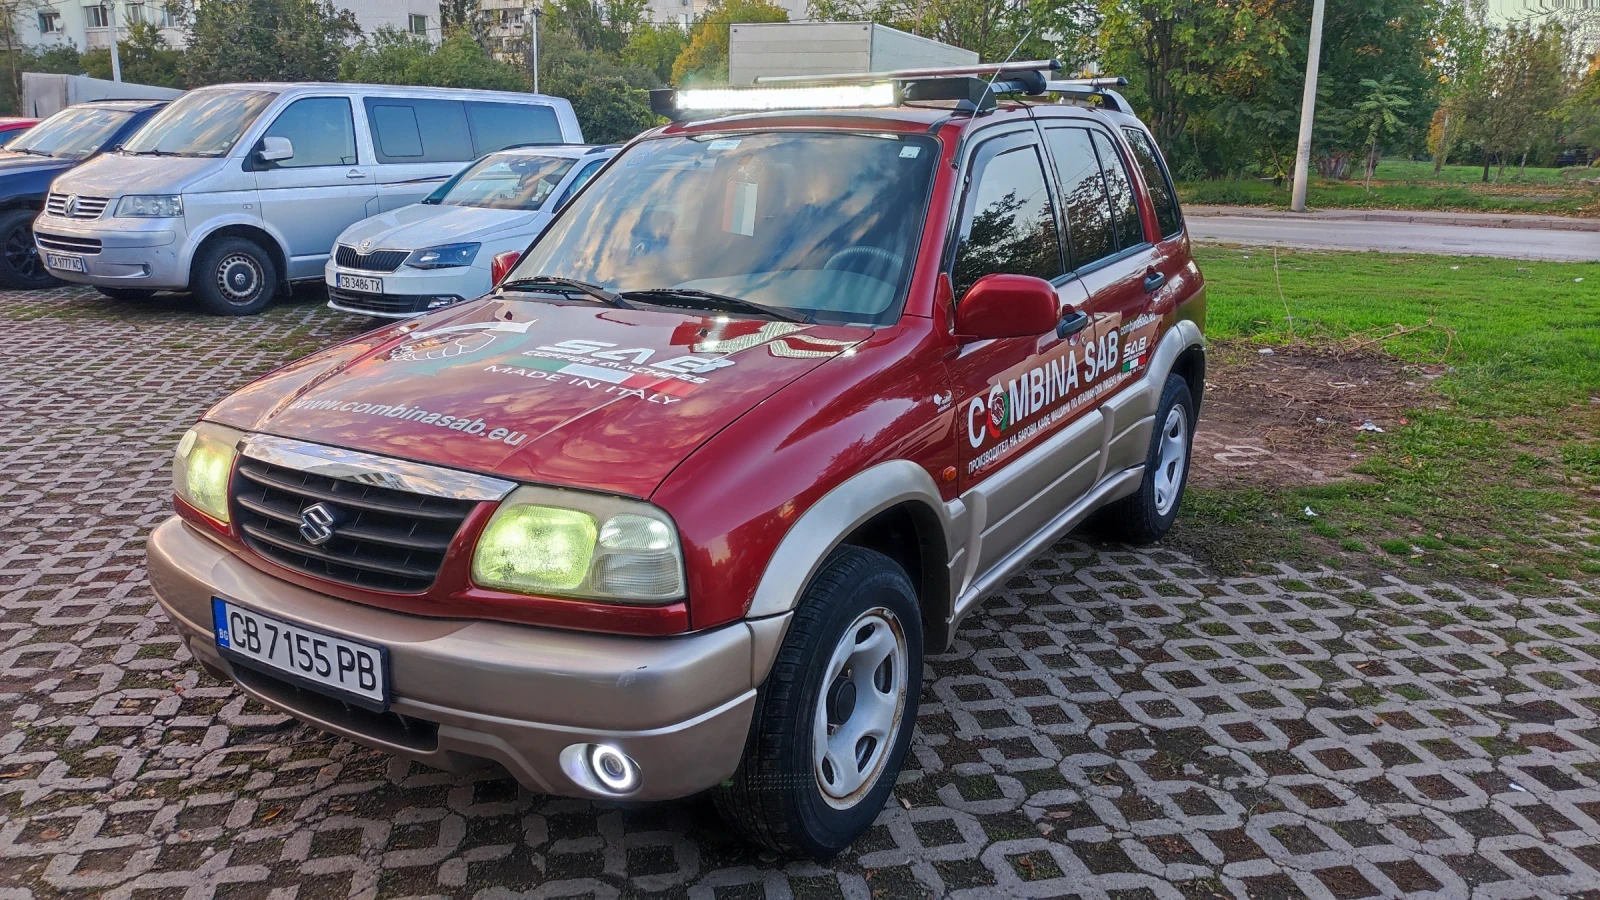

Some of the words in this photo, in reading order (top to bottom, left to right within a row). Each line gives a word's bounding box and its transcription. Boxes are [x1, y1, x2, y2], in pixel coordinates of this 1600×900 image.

[341, 276, 350, 288] CB
[351, 277, 369, 290] 3486
[370, 279, 381, 292] TX
[535, 339, 736, 374] SAB
[1122, 336, 1147, 359] SAB
[521, 349, 600, 365] COFFEE
[598, 360, 711, 385] MACHINES
[483, 364, 565, 383] MADE
[567, 377, 601, 390] IN
[604, 385, 681, 406] ITALY
[968, 350, 1079, 449] COMBINA
[1084, 330, 1119, 383] SAB
[291, 399, 527, 446] www.combinasab.eu
[1009, 434, 1018, 448] НА
[218, 628, 229, 641] BG
[230, 611, 261, 654] CB
[264, 622, 331, 677] 7155
[337, 644, 377, 691] PB
